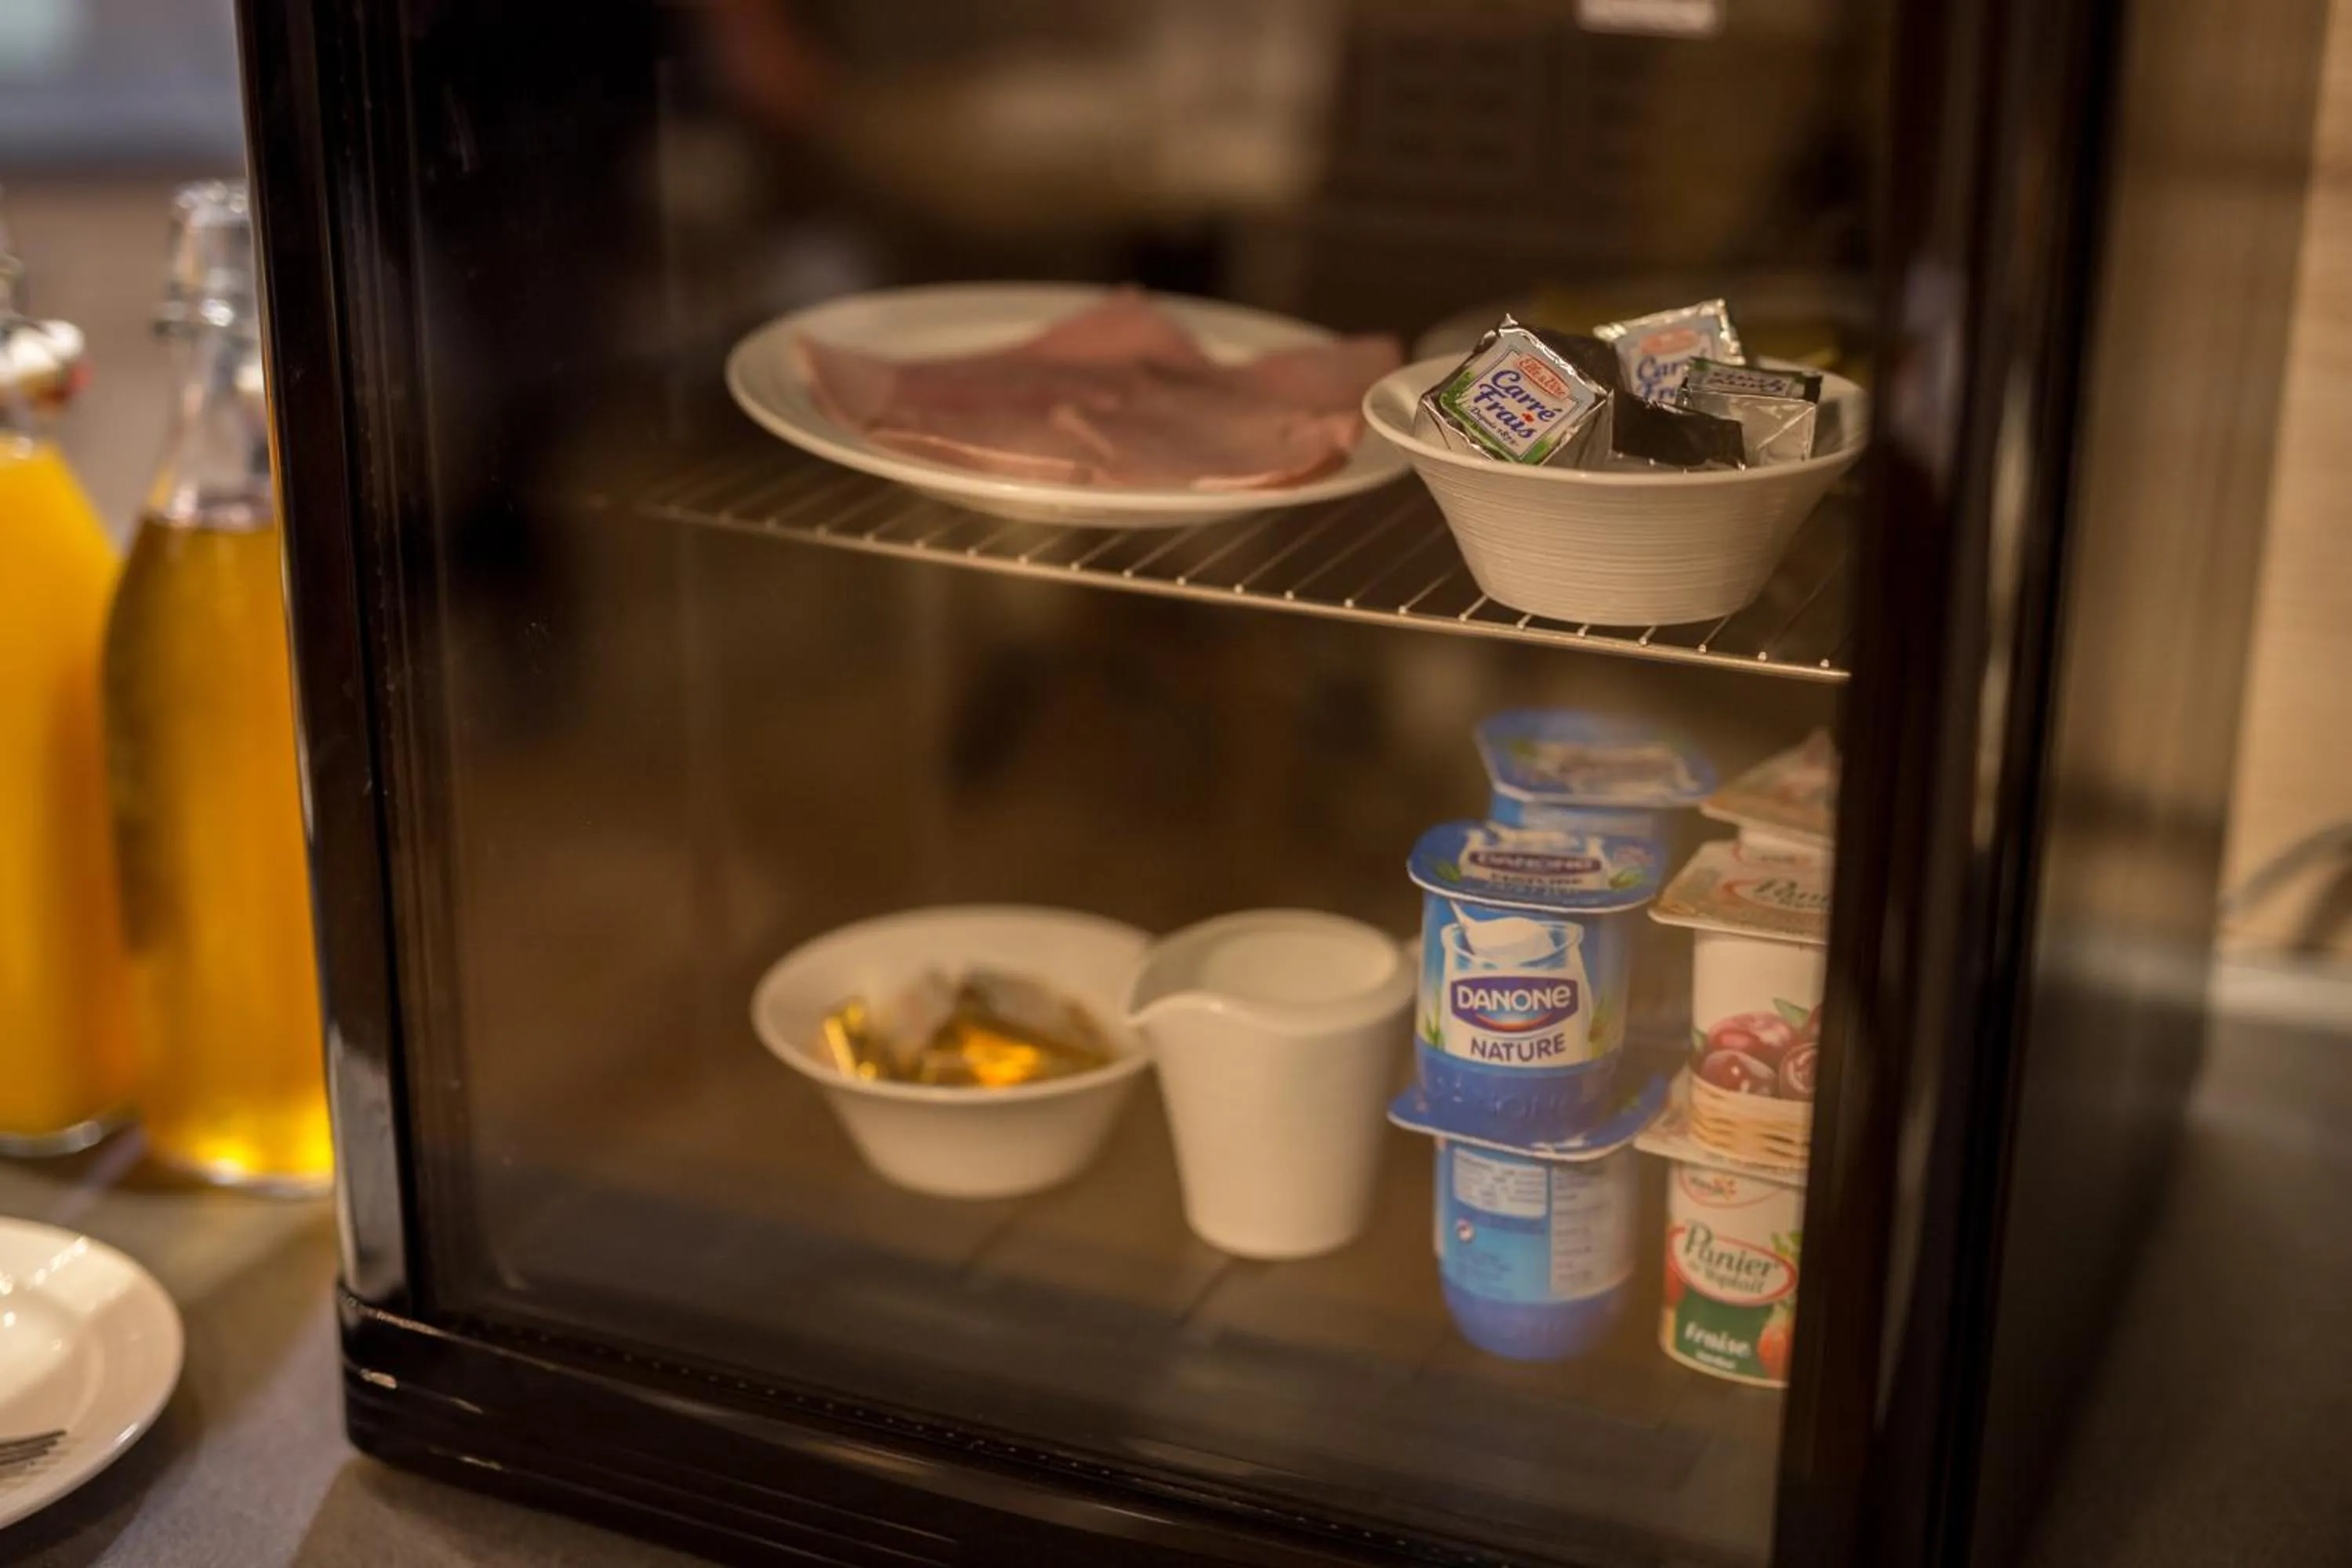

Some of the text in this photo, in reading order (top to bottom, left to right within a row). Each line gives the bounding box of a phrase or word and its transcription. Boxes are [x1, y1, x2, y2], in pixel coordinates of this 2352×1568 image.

[1473, 383, 1537, 439] Frais
[1491, 369, 1563, 423] Carré
[1456, 985, 1571, 1011] DANONE
[1469, 1033, 1567, 1062] NATURE
[1685, 1219, 1773, 1277] Panier
